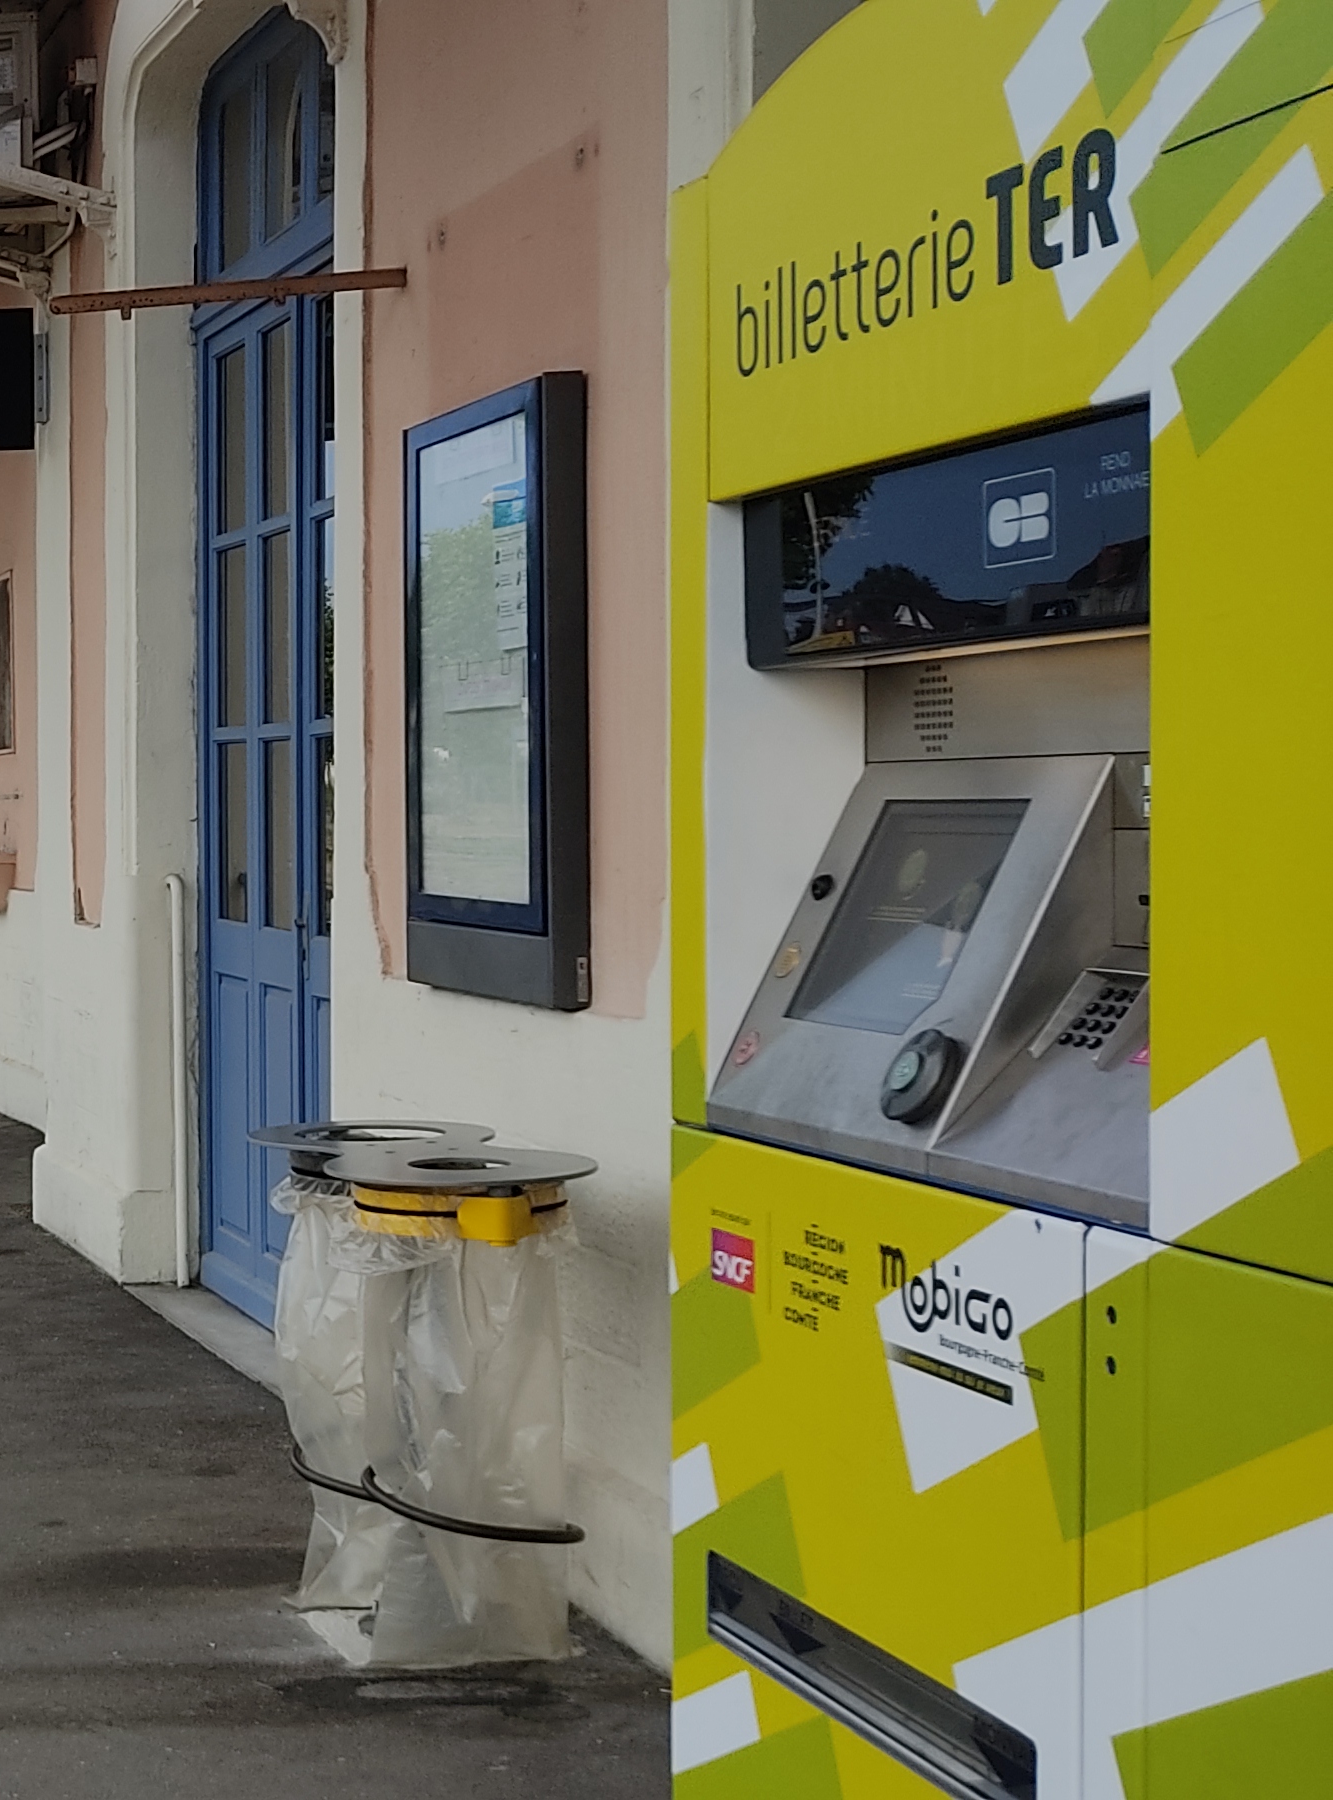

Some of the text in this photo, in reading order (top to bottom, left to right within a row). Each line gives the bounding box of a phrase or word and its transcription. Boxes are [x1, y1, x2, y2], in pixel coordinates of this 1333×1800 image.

[737, 128, 1119, 377] billetterie TER
[711, 1250, 754, 1283] SNCF
